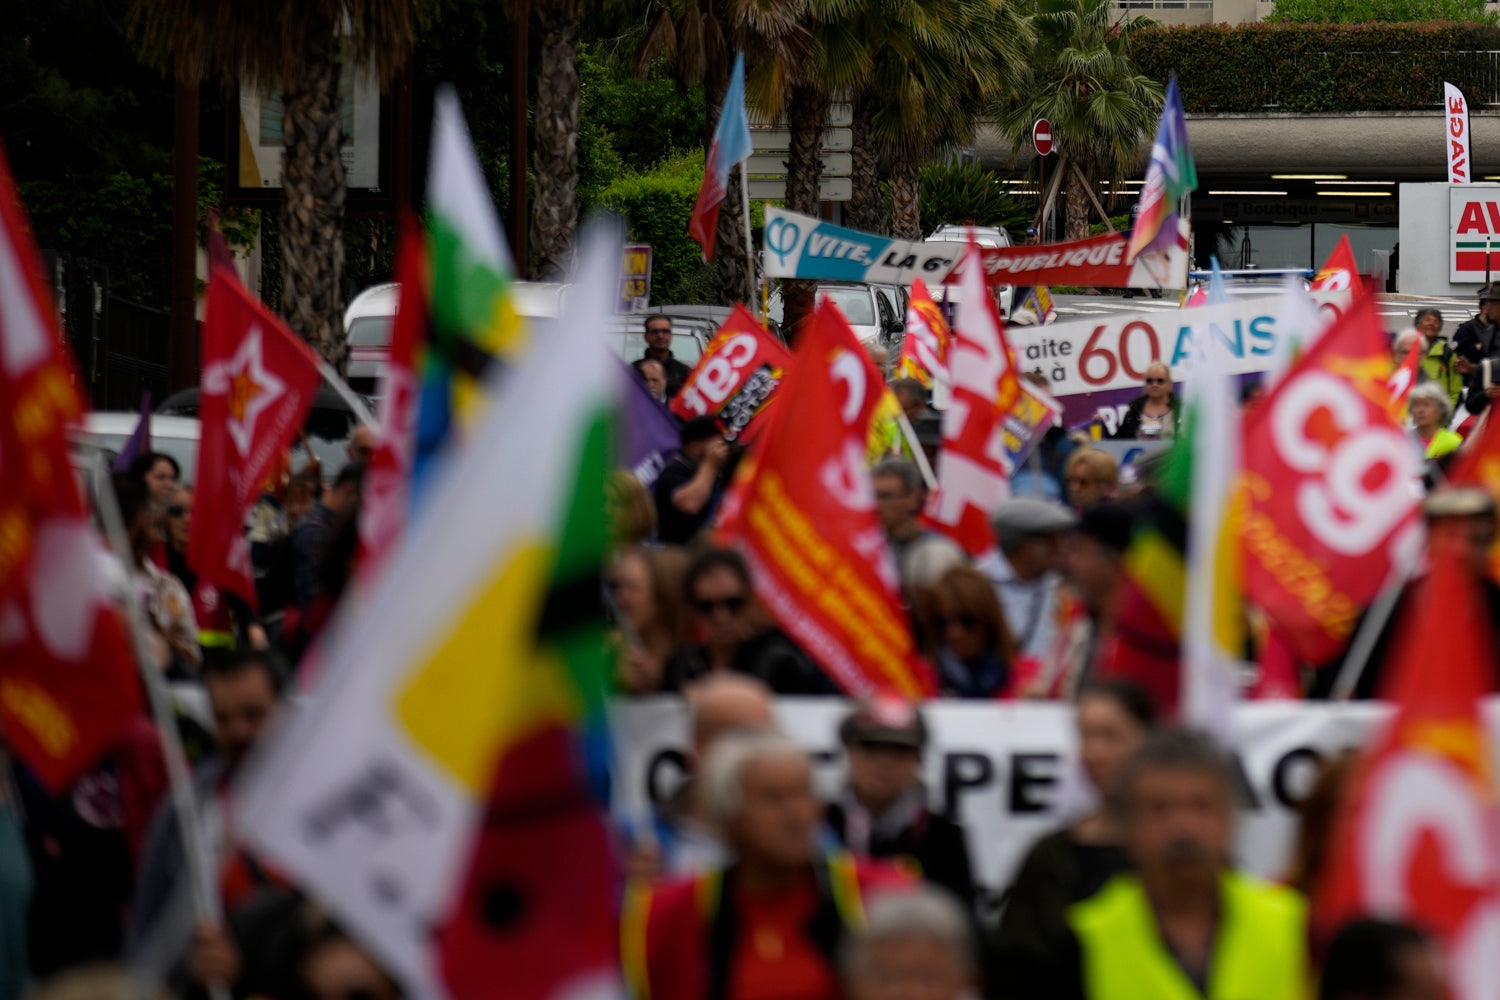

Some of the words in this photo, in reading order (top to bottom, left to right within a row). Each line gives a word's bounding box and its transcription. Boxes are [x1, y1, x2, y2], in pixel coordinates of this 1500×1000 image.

[1243, 203, 1318, 218] Boutique
[807, 231, 874, 266] VITE,
[882, 250, 916, 269] LA
[1077, 320, 1161, 386] 60
[1170, 315, 1278, 368] ANS
